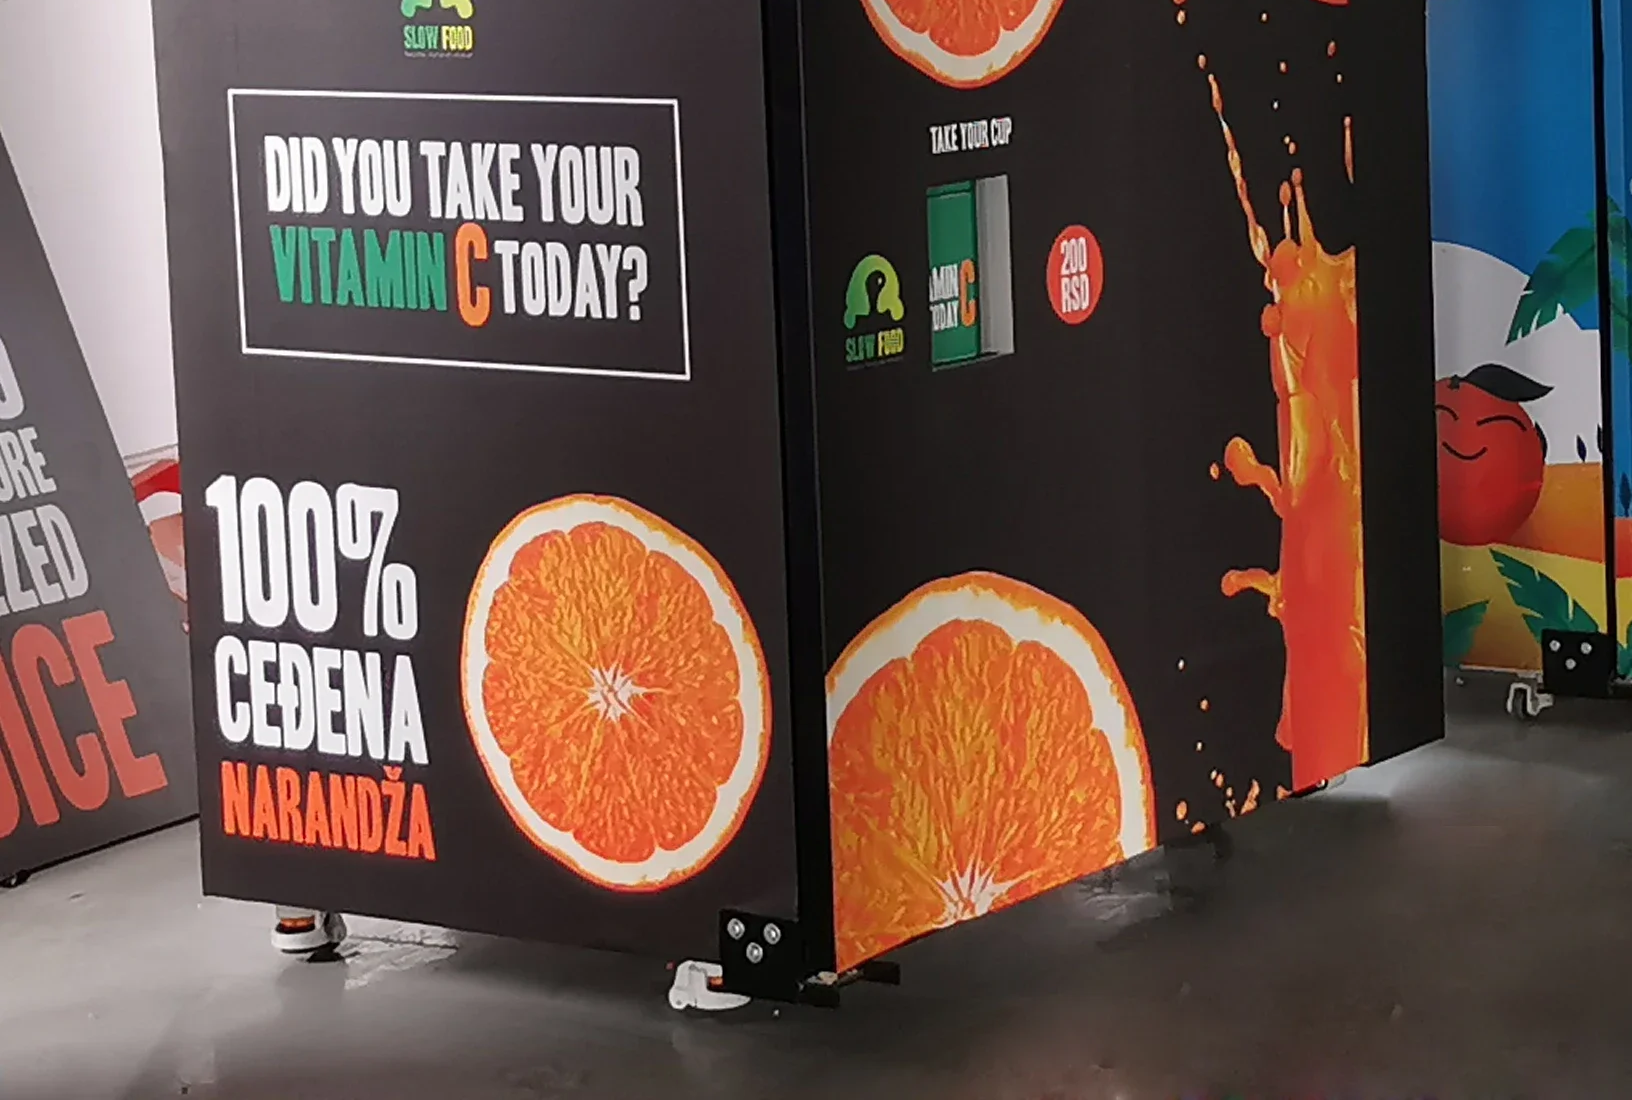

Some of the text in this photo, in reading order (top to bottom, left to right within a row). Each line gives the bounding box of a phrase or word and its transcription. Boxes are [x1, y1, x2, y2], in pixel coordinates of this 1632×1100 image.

[403, 25, 473, 51] SLOW FOOD
[264, 135, 644, 227] DID YOU TAKE YOUR
[929, 117, 1012, 154] TAKE YOUR CUP
[269, 222, 648, 327] VITAMIN C TODAY?
[1060, 236, 1087, 276] 200
[1061, 273, 1090, 314] RSD
[0, 504, 90, 617] ZED
[205, 474, 419, 641] 100%
[214, 635, 429, 765] CEĐENA
[220, 761, 437, 862] NARANDŽA
